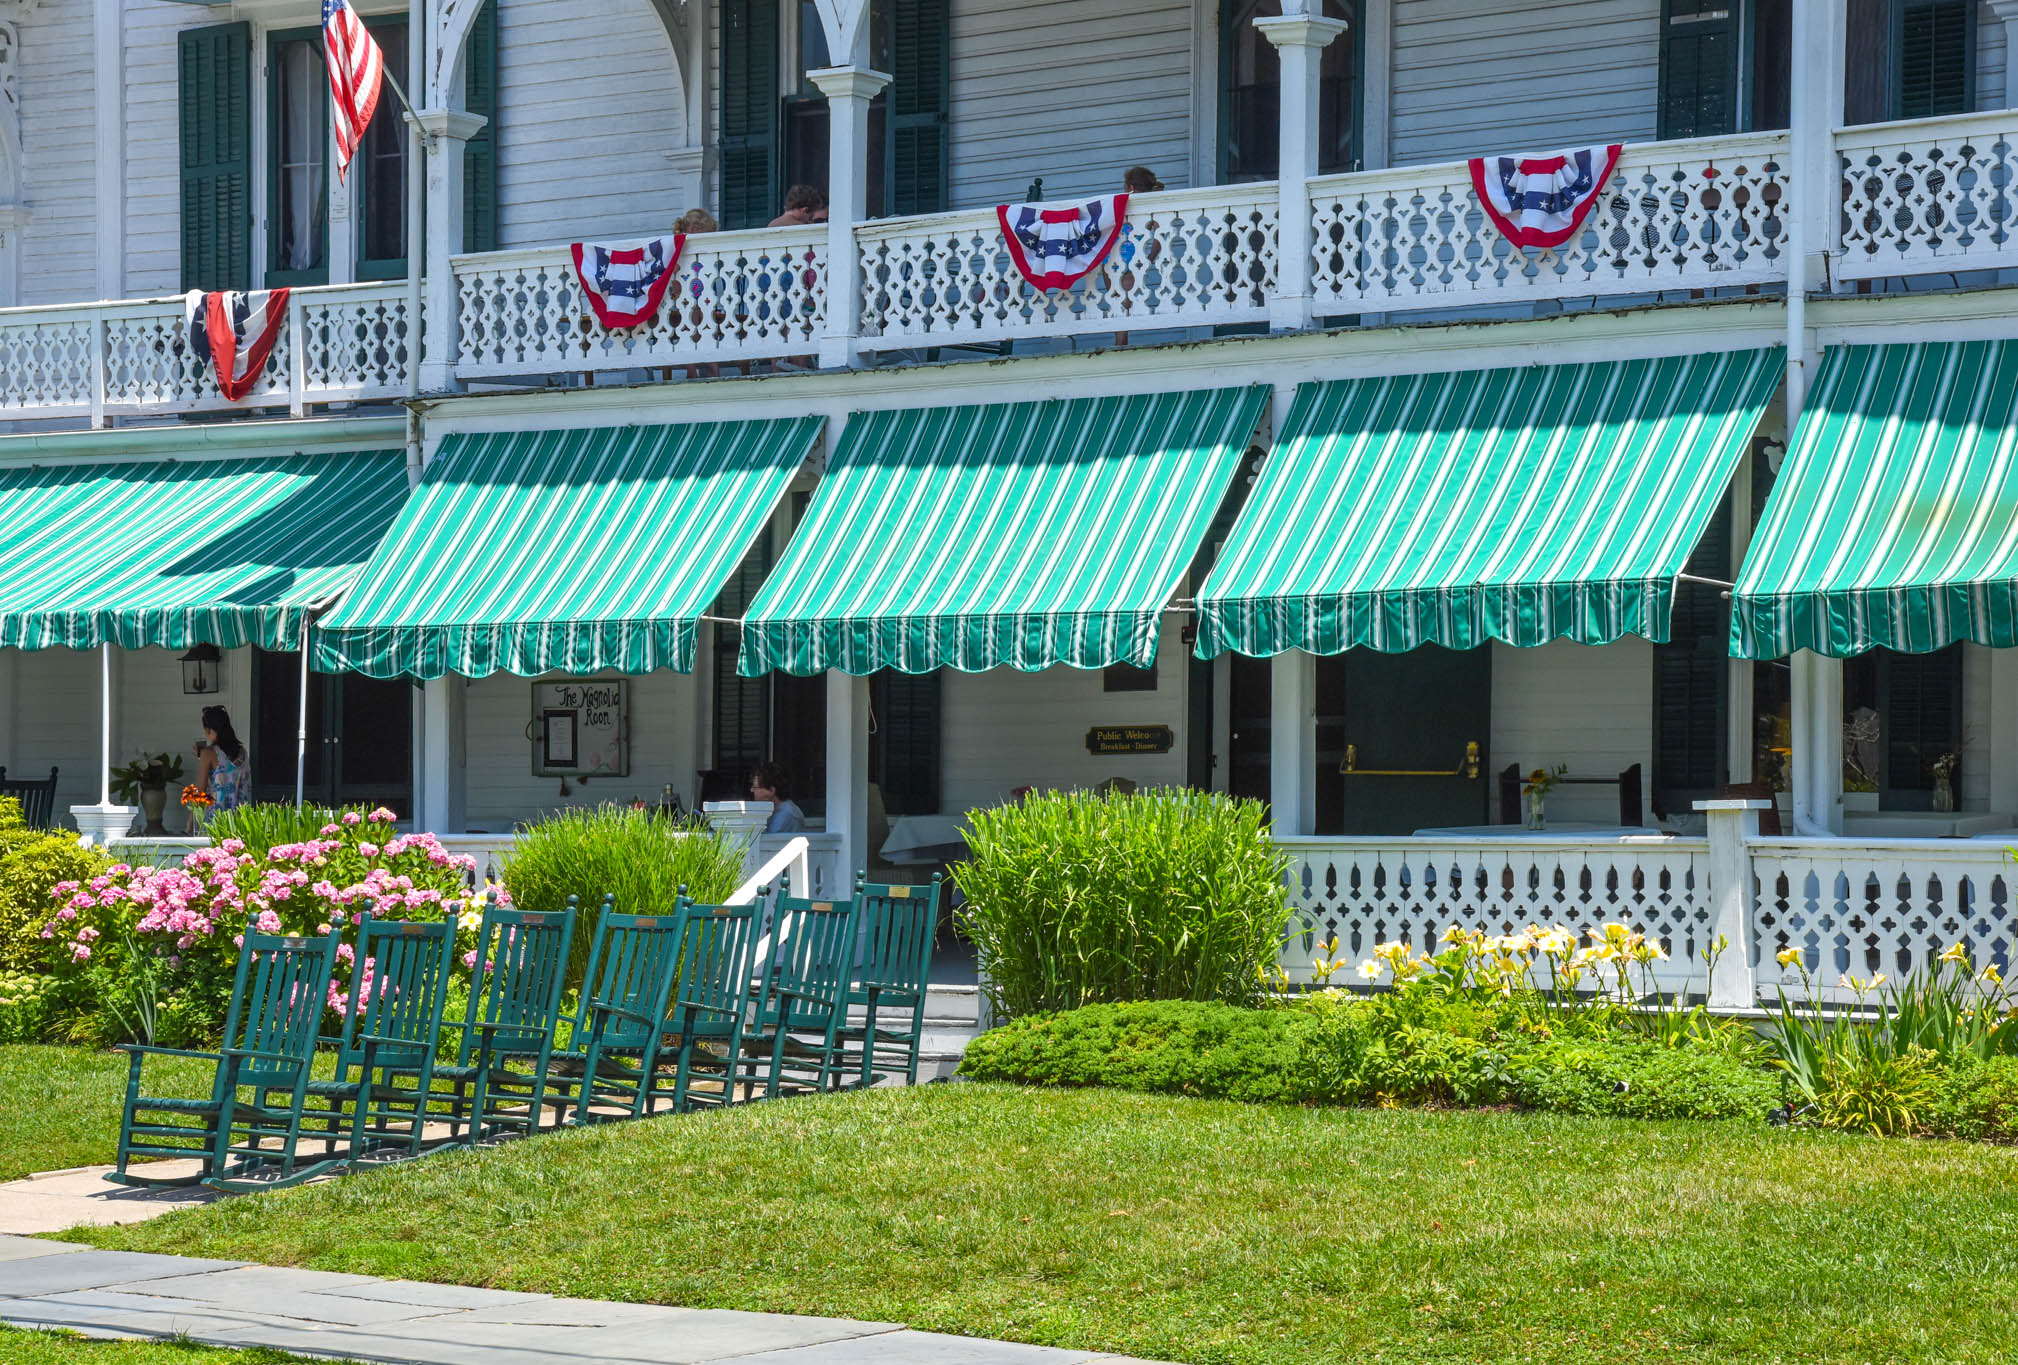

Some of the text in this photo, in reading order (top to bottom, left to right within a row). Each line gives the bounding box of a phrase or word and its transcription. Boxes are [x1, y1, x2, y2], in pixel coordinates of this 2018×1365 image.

[555, 686, 619, 709] The Magnolia
[1097, 730, 1121, 741] Public
